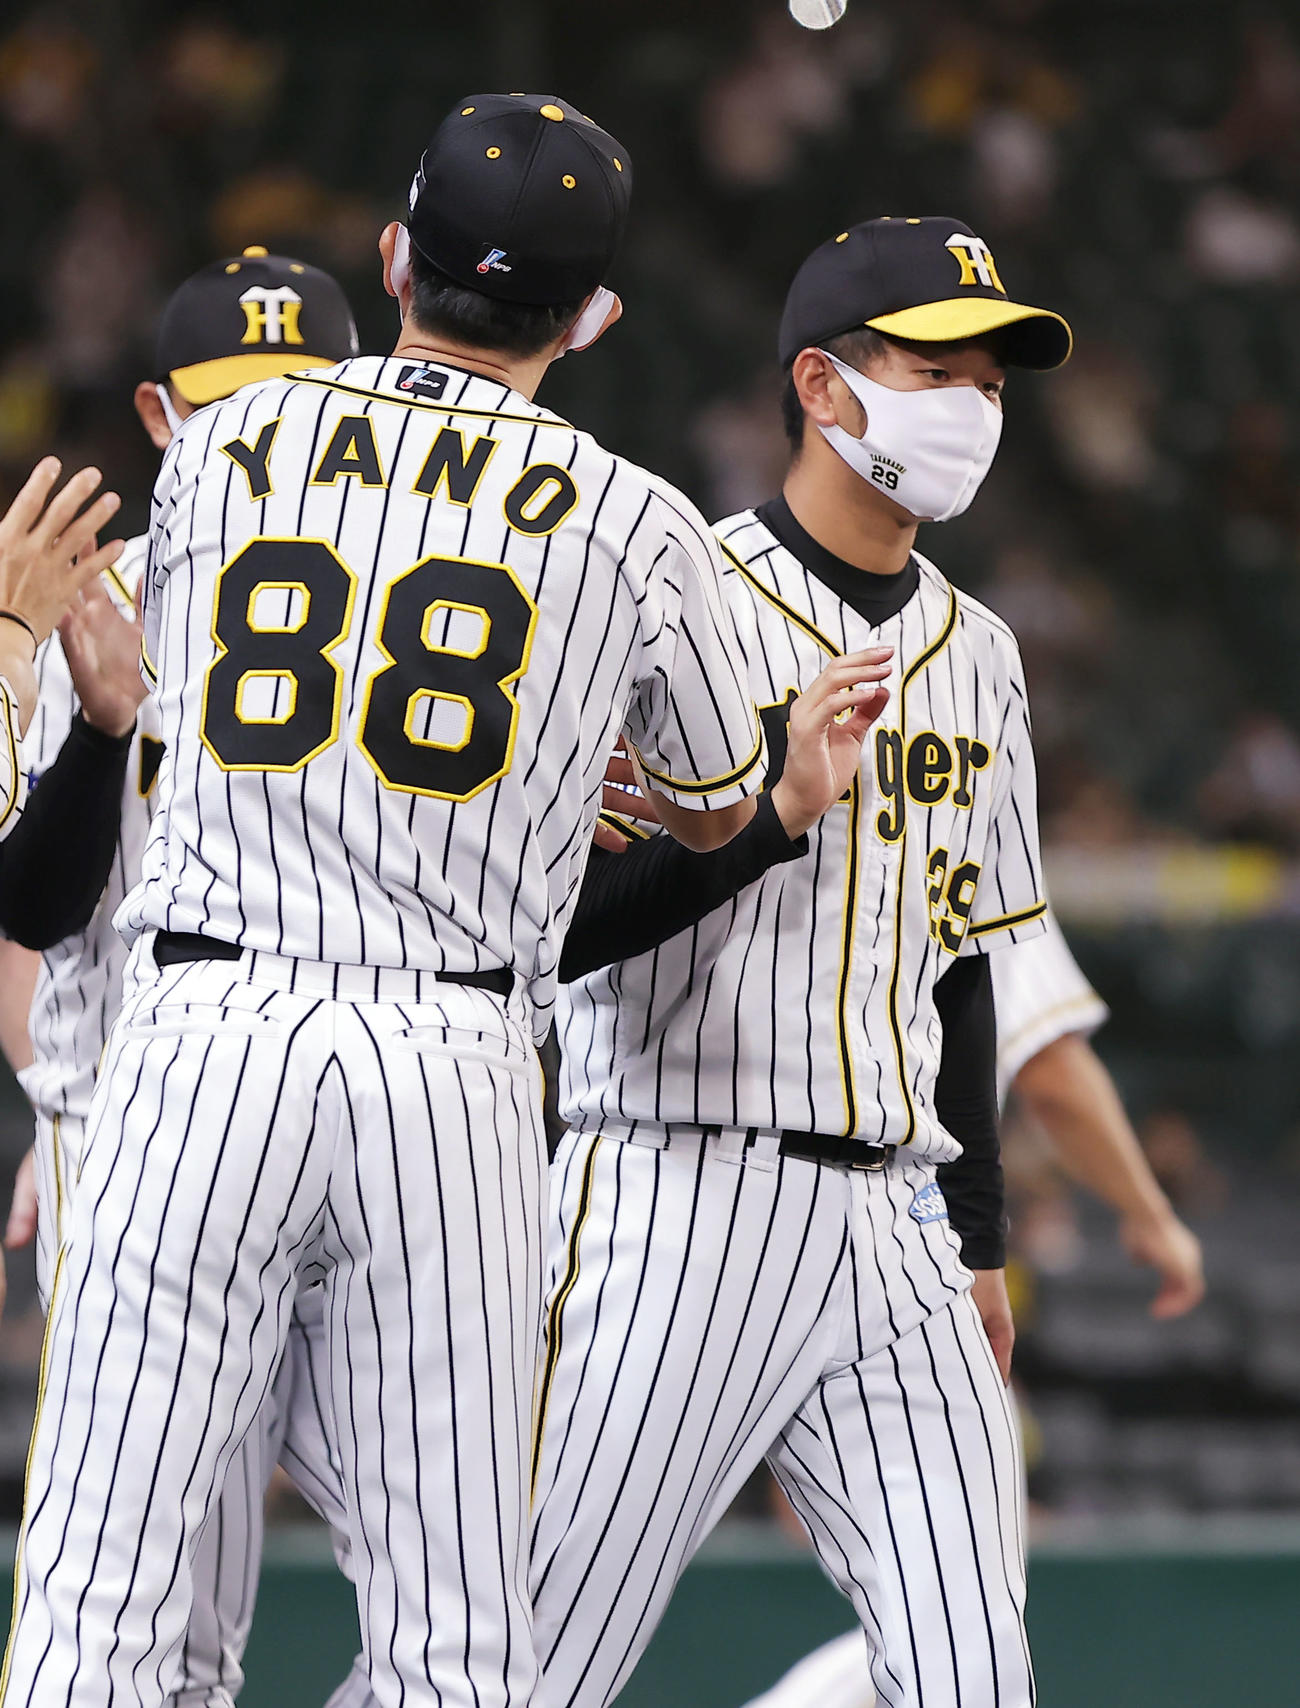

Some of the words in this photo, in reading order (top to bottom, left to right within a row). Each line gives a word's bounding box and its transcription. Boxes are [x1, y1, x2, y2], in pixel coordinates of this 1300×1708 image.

[219, 415, 580, 538] YANO
[871, 464, 899, 490] 29
[199, 535, 540, 803] 88
[926, 846, 982, 956] 29
